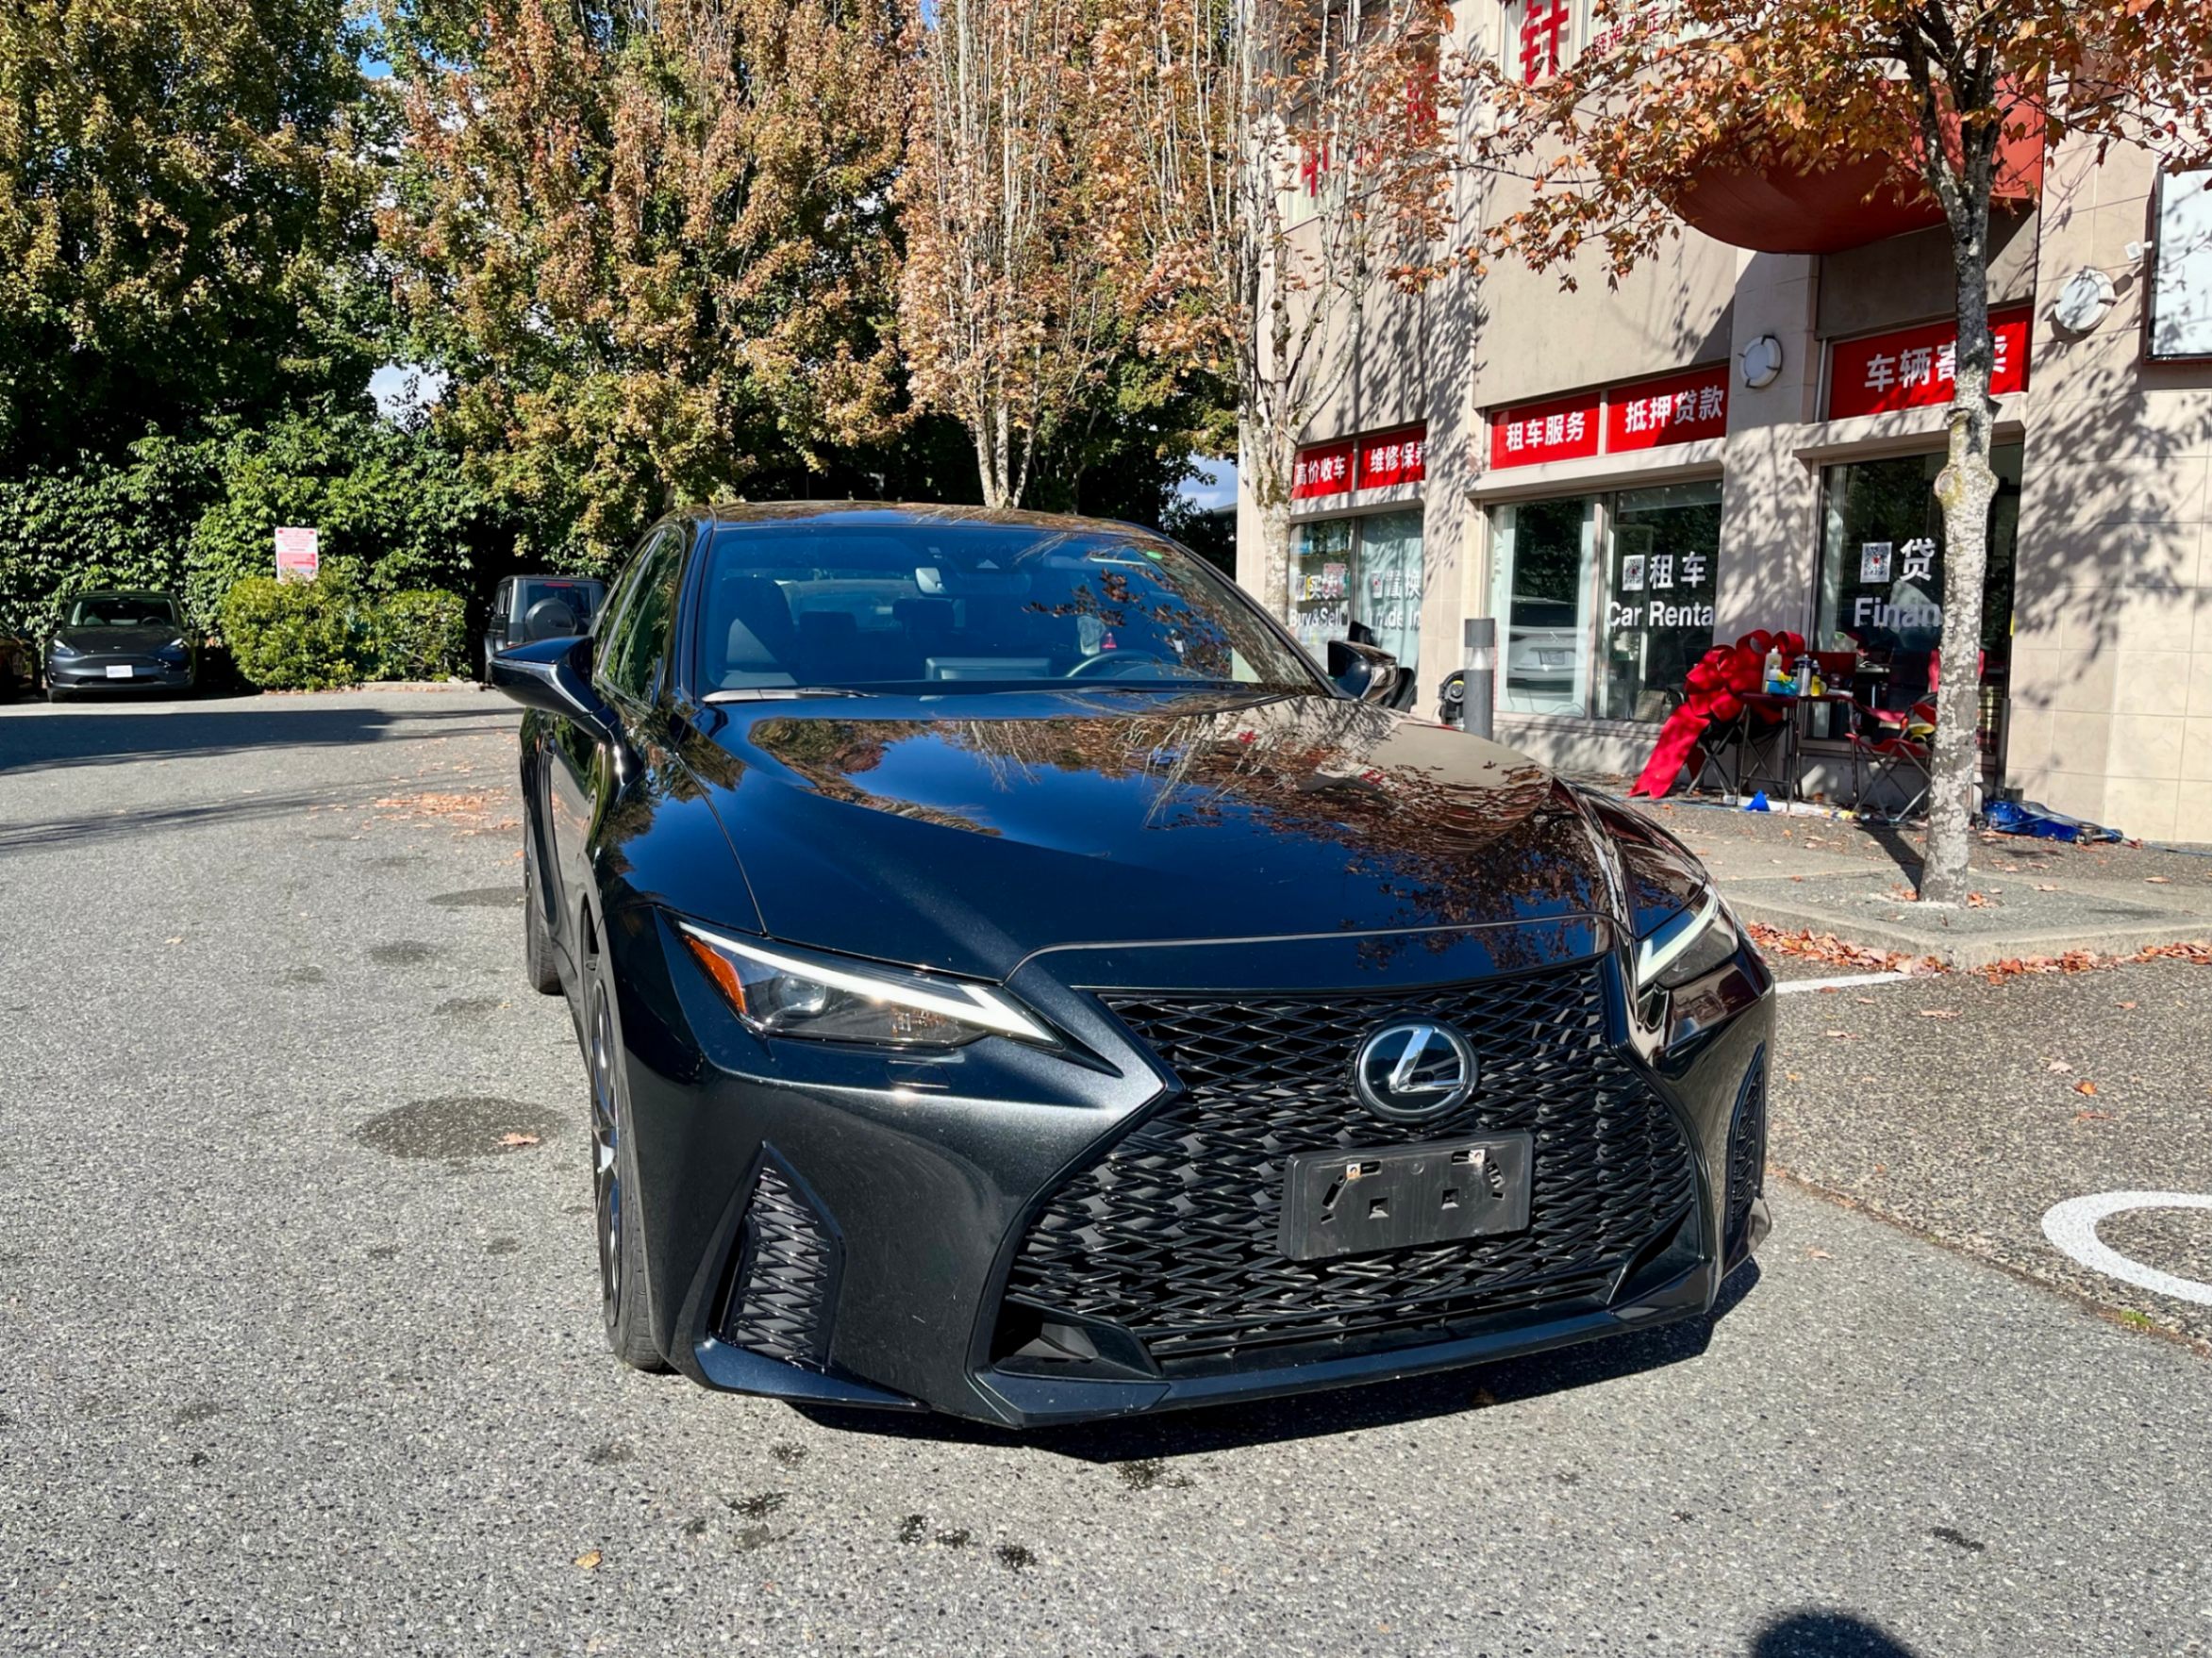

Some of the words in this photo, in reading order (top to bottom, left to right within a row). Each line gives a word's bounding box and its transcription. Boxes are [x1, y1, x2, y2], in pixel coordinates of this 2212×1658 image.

[1624, 385, 1724, 434] 抵押贷款
[1506, 411, 1586, 452] 租车服务
[1295, 456, 1346, 487] 高价收车
[1386, 568, 1422, 600] 置换
[1649, 551, 1706, 589] 租车
[1289, 606, 1343, 628] Buy&Sell
[1608, 601, 1643, 626] Car
[1649, 601, 1714, 626] Renta
